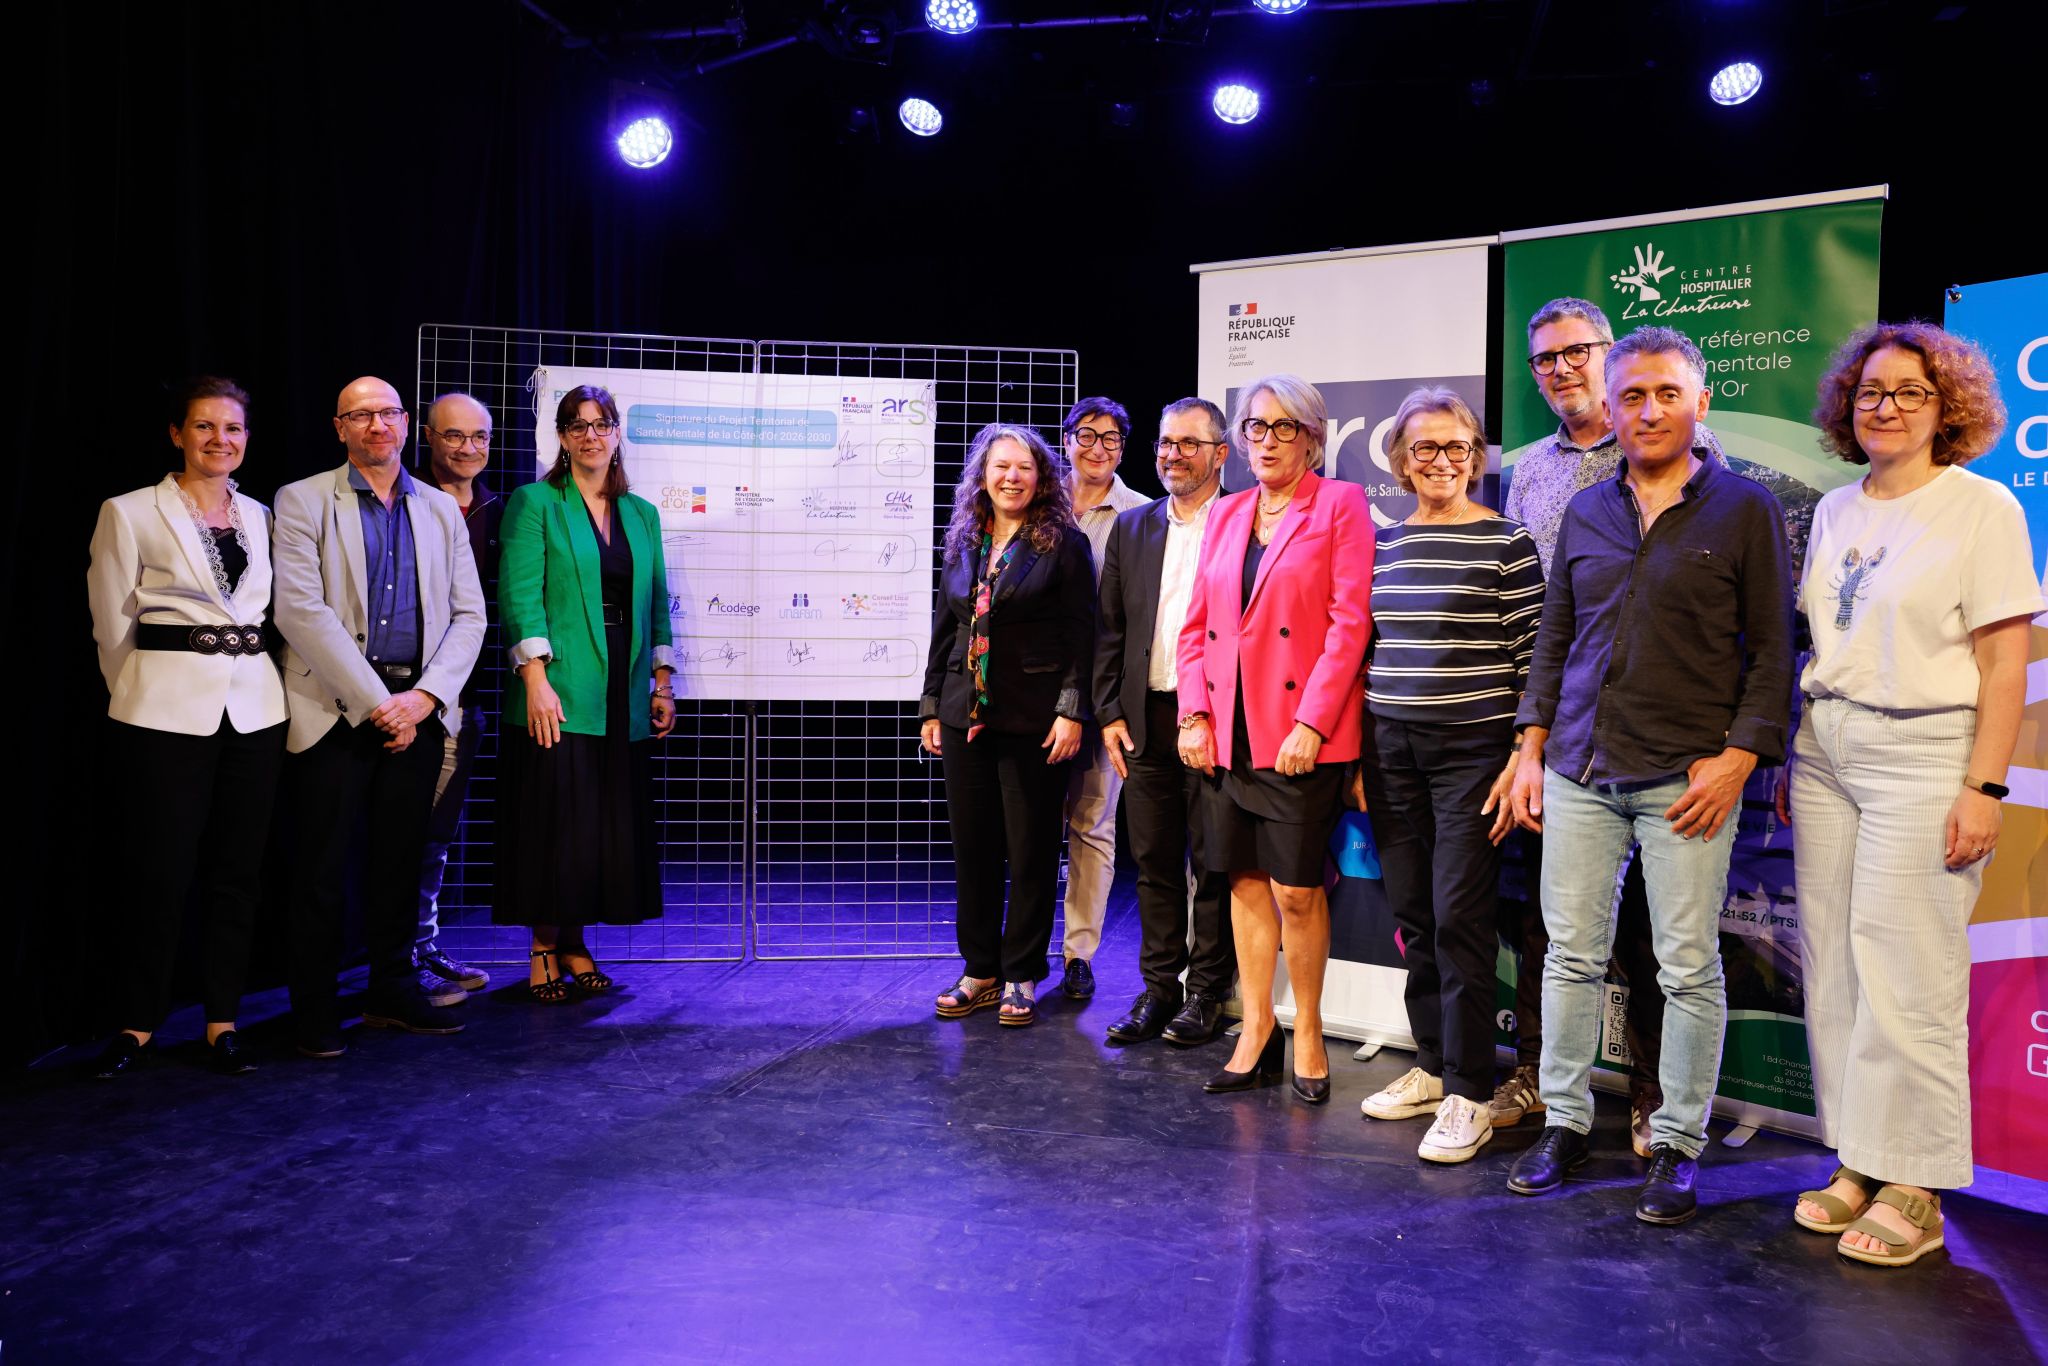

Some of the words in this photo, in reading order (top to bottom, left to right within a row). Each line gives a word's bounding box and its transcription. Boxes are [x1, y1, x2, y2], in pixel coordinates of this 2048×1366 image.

[1680, 264, 1752, 280] CENTRE
[1680, 277, 1752, 294] HOSPITALIER
[1622, 301, 1649, 320] La
[1654, 294, 1752, 317] Chartreuse
[1228, 316, 1296, 331] RÉPUBLIQUE
[1228, 328, 1291, 342] FRANÇAISE
[1700, 328, 1811, 349] référence
[881, 398, 927, 425] ars
[655, 413, 704, 425] Signature
[705, 414, 716, 424] du
[719, 415, 747, 427] Projet
[635, 427, 664, 438] Santé
[666, 429, 705, 439] Mentale
[2013, 472, 2036, 487] LE
[661, 486, 690, 498] Côte
[886, 490, 913, 504] CHU
[661, 497, 690, 509] d'Or
[1722, 910, 1757, 924] 21-52
[1784, 1068, 1808, 1080] 21000
[1773, 1075, 1784, 1085] 03
[1784, 1078, 1796, 1087] 80
[1796, 1080, 1807, 1089] 42
